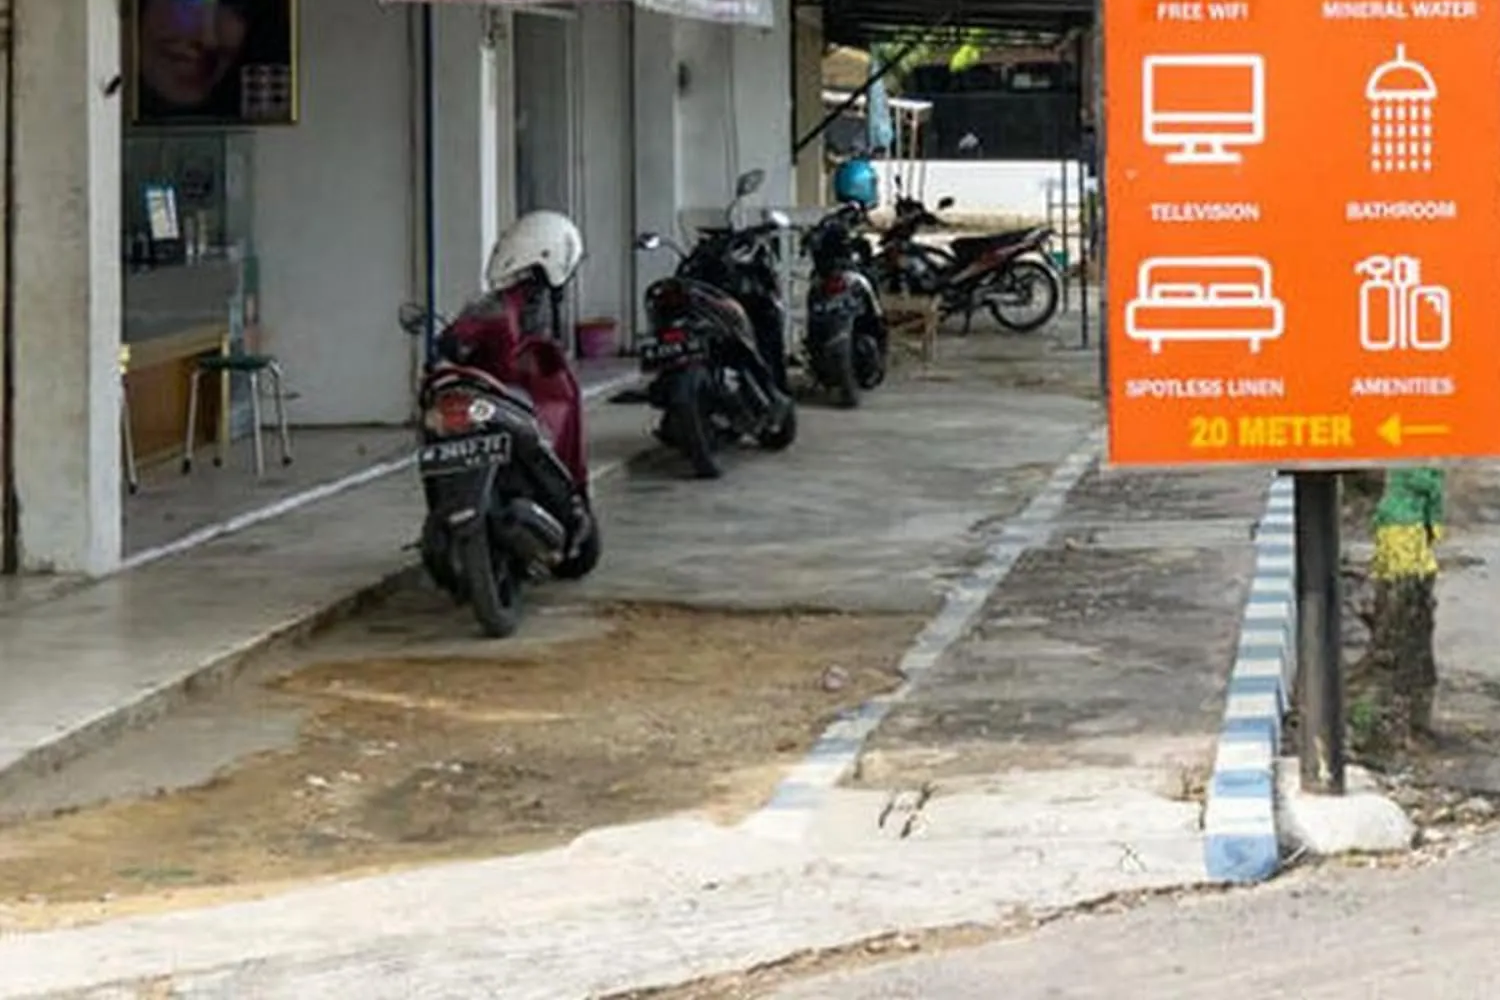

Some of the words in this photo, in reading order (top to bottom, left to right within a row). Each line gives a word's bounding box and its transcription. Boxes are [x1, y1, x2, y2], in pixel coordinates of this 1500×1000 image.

[1157, 1, 1202, 20] FREE
[1321, 0, 1406, 19] MINERAL
[1411, 0, 1477, 18] WATER
[1150, 202, 1260, 221] TELEVISION
[1346, 201, 1457, 219] BATHROOM
[1126, 379, 1222, 398] SPOTLESS
[1227, 378, 1284, 397] LINEN
[1351, 377, 1455, 396] AMENITIES
[1189, 415, 1230, 448] 20
[1238, 414, 1355, 447] METER
